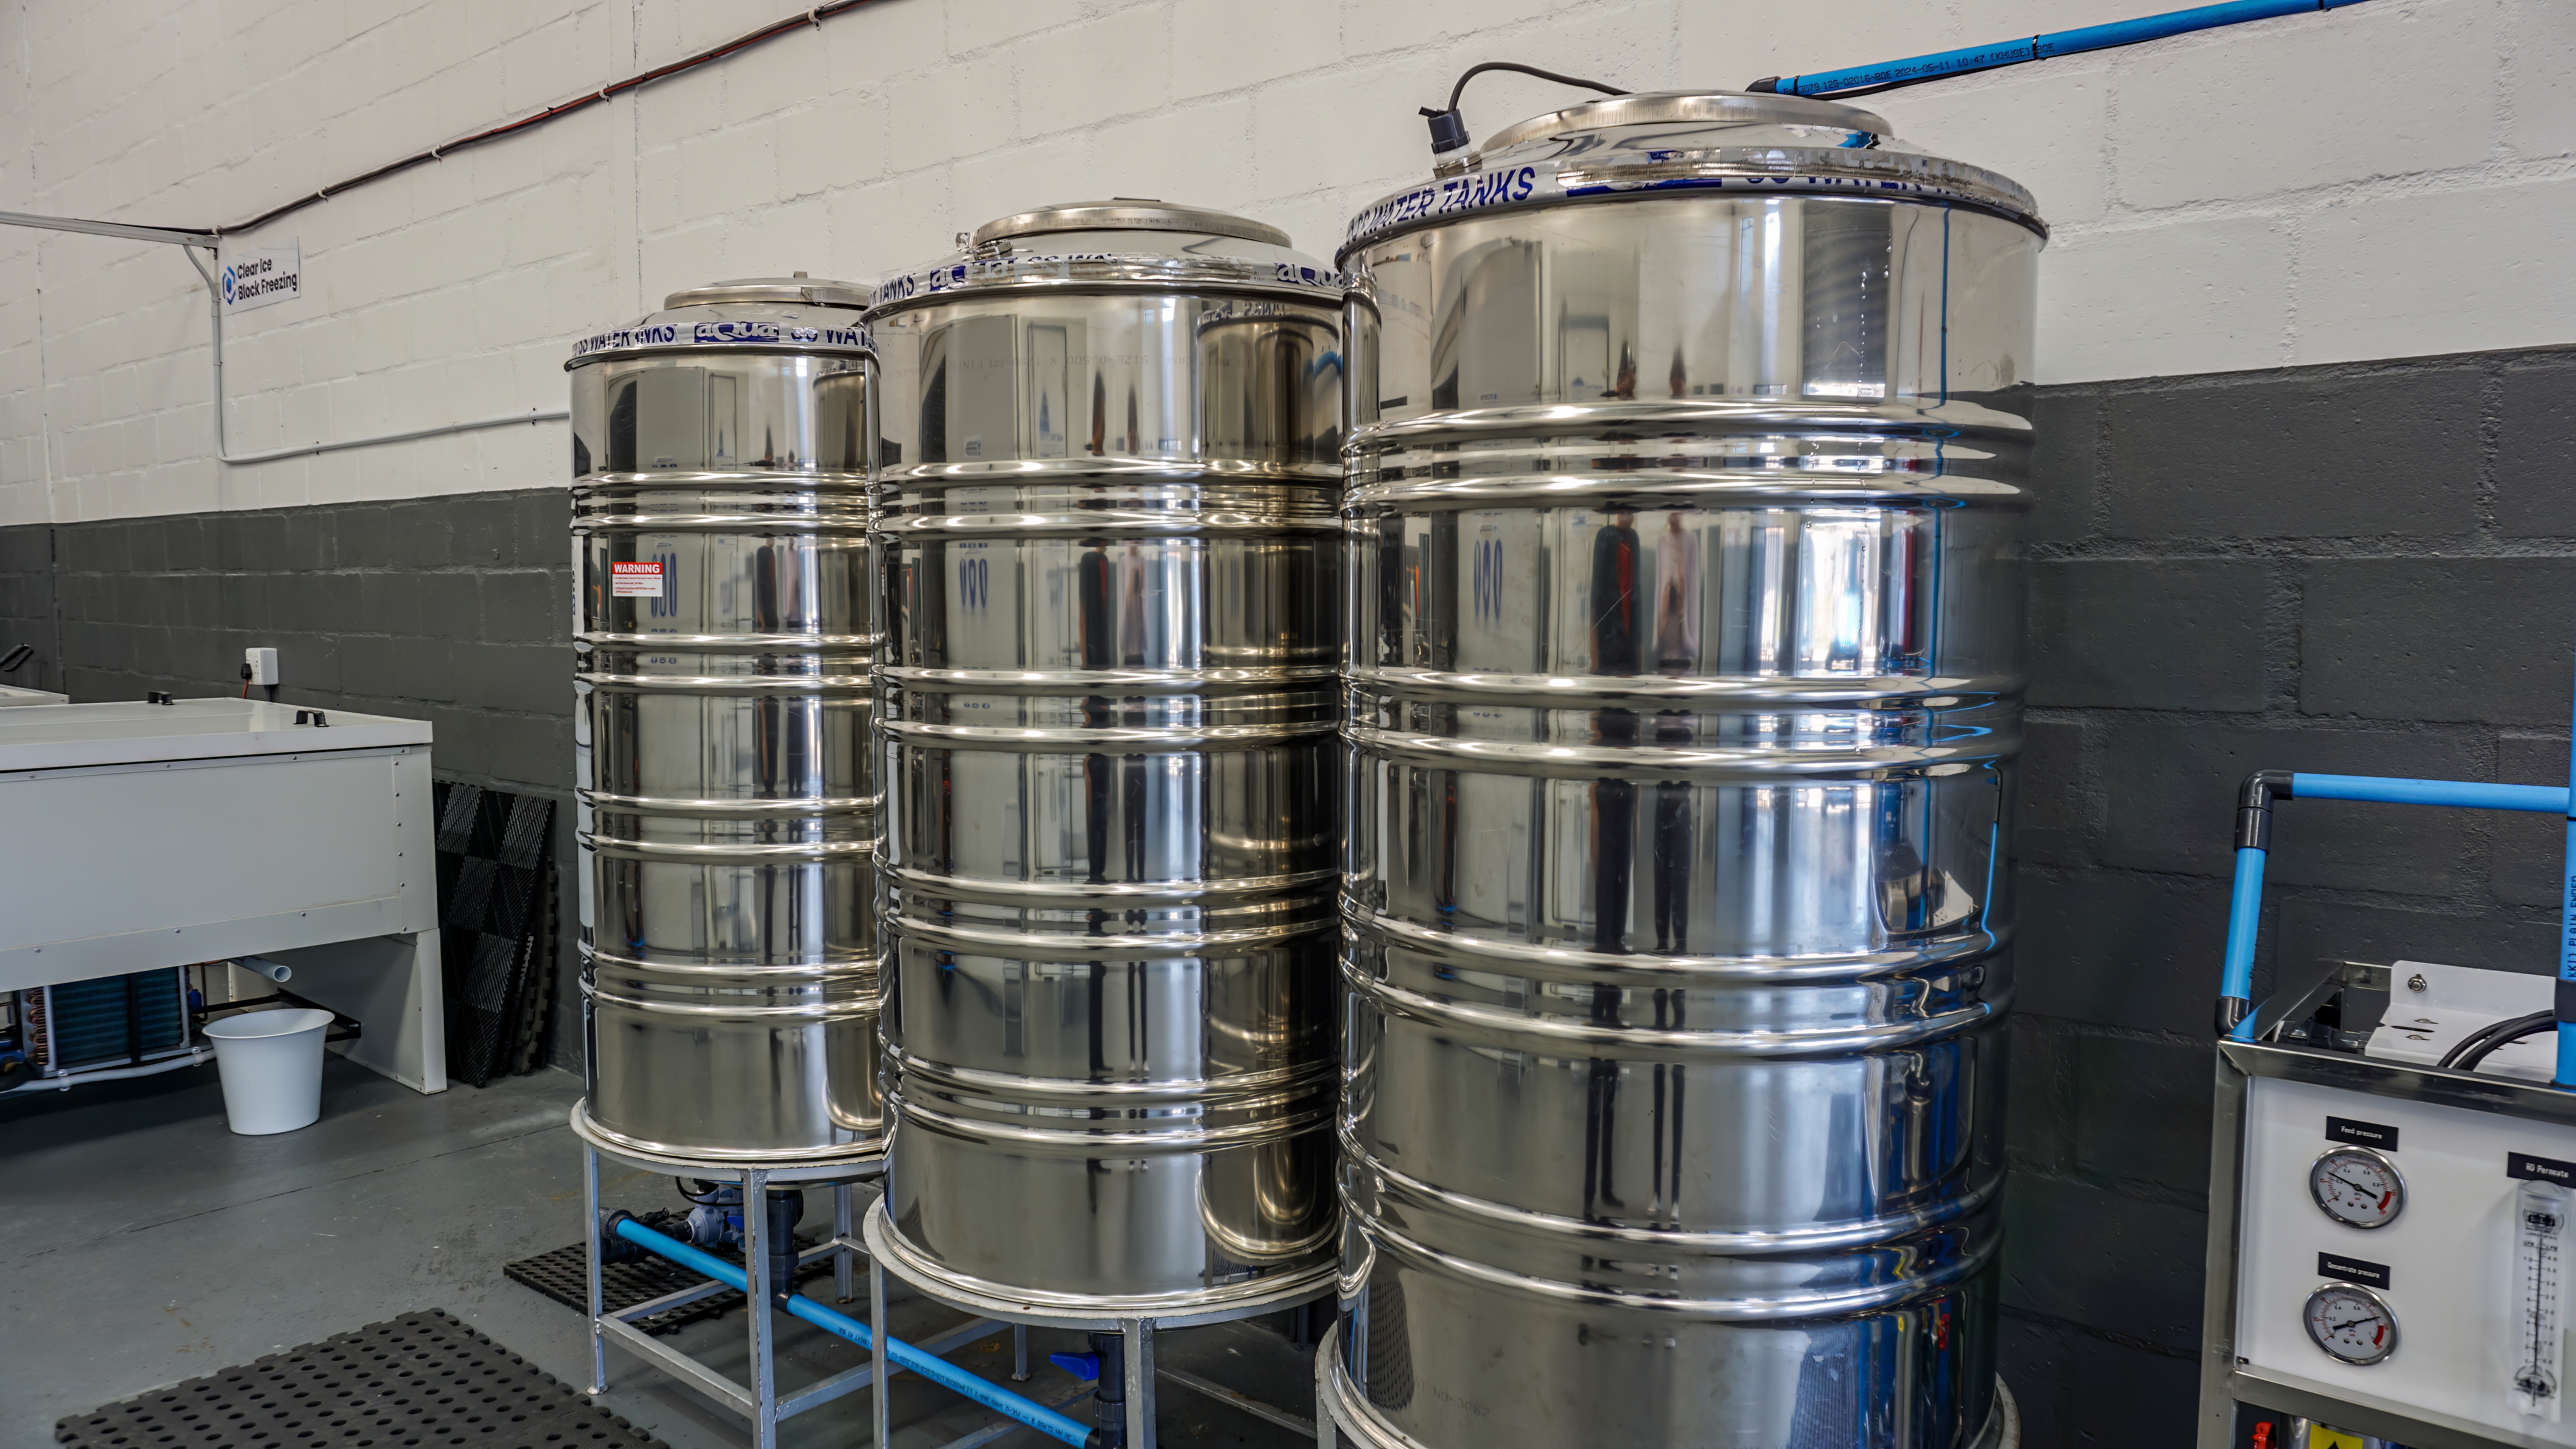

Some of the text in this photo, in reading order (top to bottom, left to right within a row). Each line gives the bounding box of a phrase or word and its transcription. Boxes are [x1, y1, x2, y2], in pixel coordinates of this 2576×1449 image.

[1957, 55, 1984, 68] 10:47
[1439, 167, 1535, 214] TANKS
[237, 258, 272, 279] Clear Ice
[238, 271, 297, 300] Block Freezing
[614, 564, 660, 573] WARNING
[1038, 1421, 1053, 1432] CLASS
